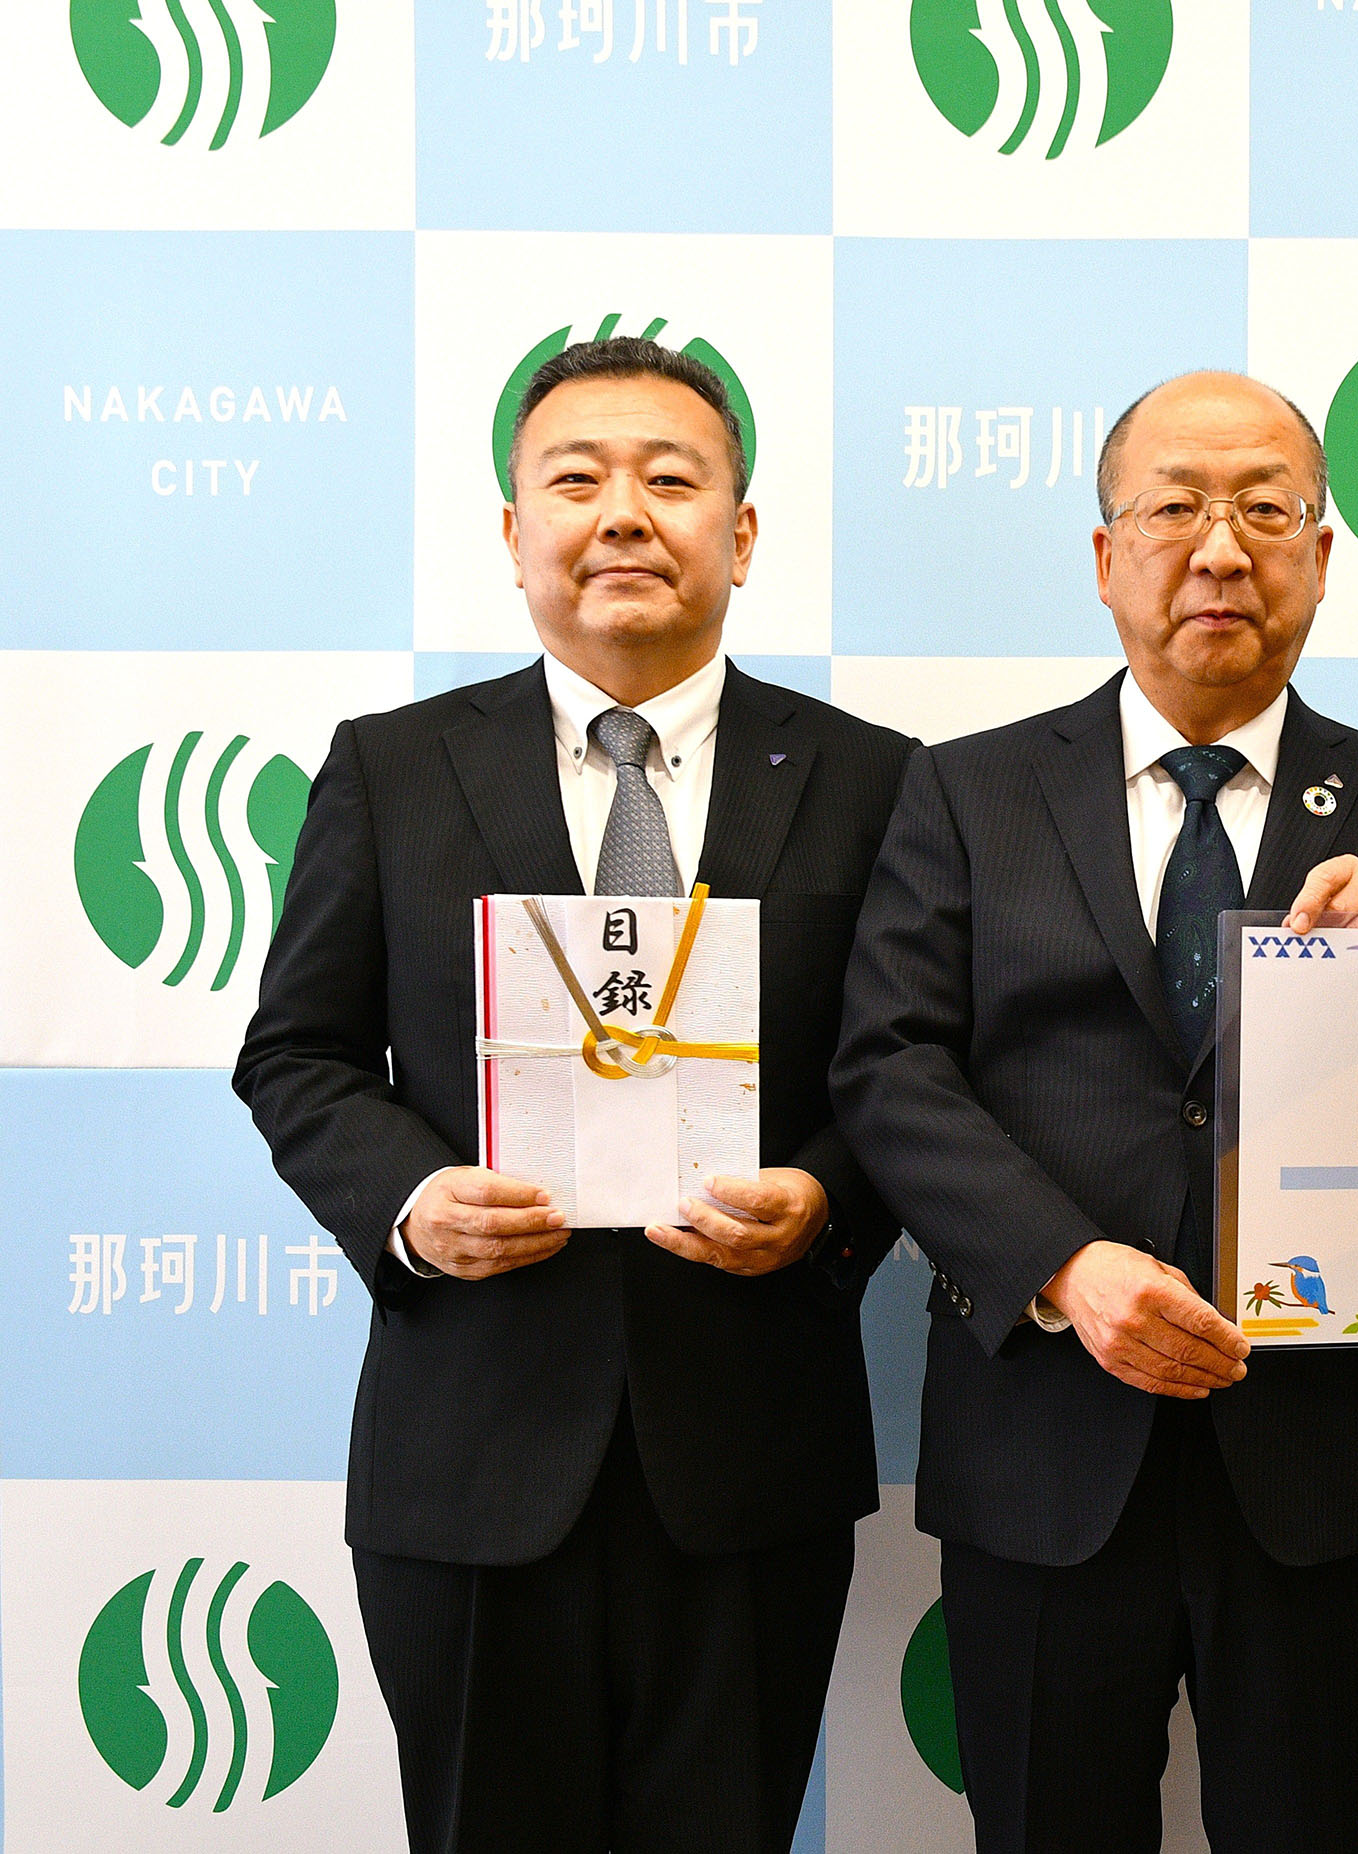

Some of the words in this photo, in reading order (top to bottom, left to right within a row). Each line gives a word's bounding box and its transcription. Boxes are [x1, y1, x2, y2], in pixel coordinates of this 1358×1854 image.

[64, 385, 348, 423] NAKAGAWA
[151, 459, 261, 496] CITY
[68, 1234, 345, 1317] 那珂川市
